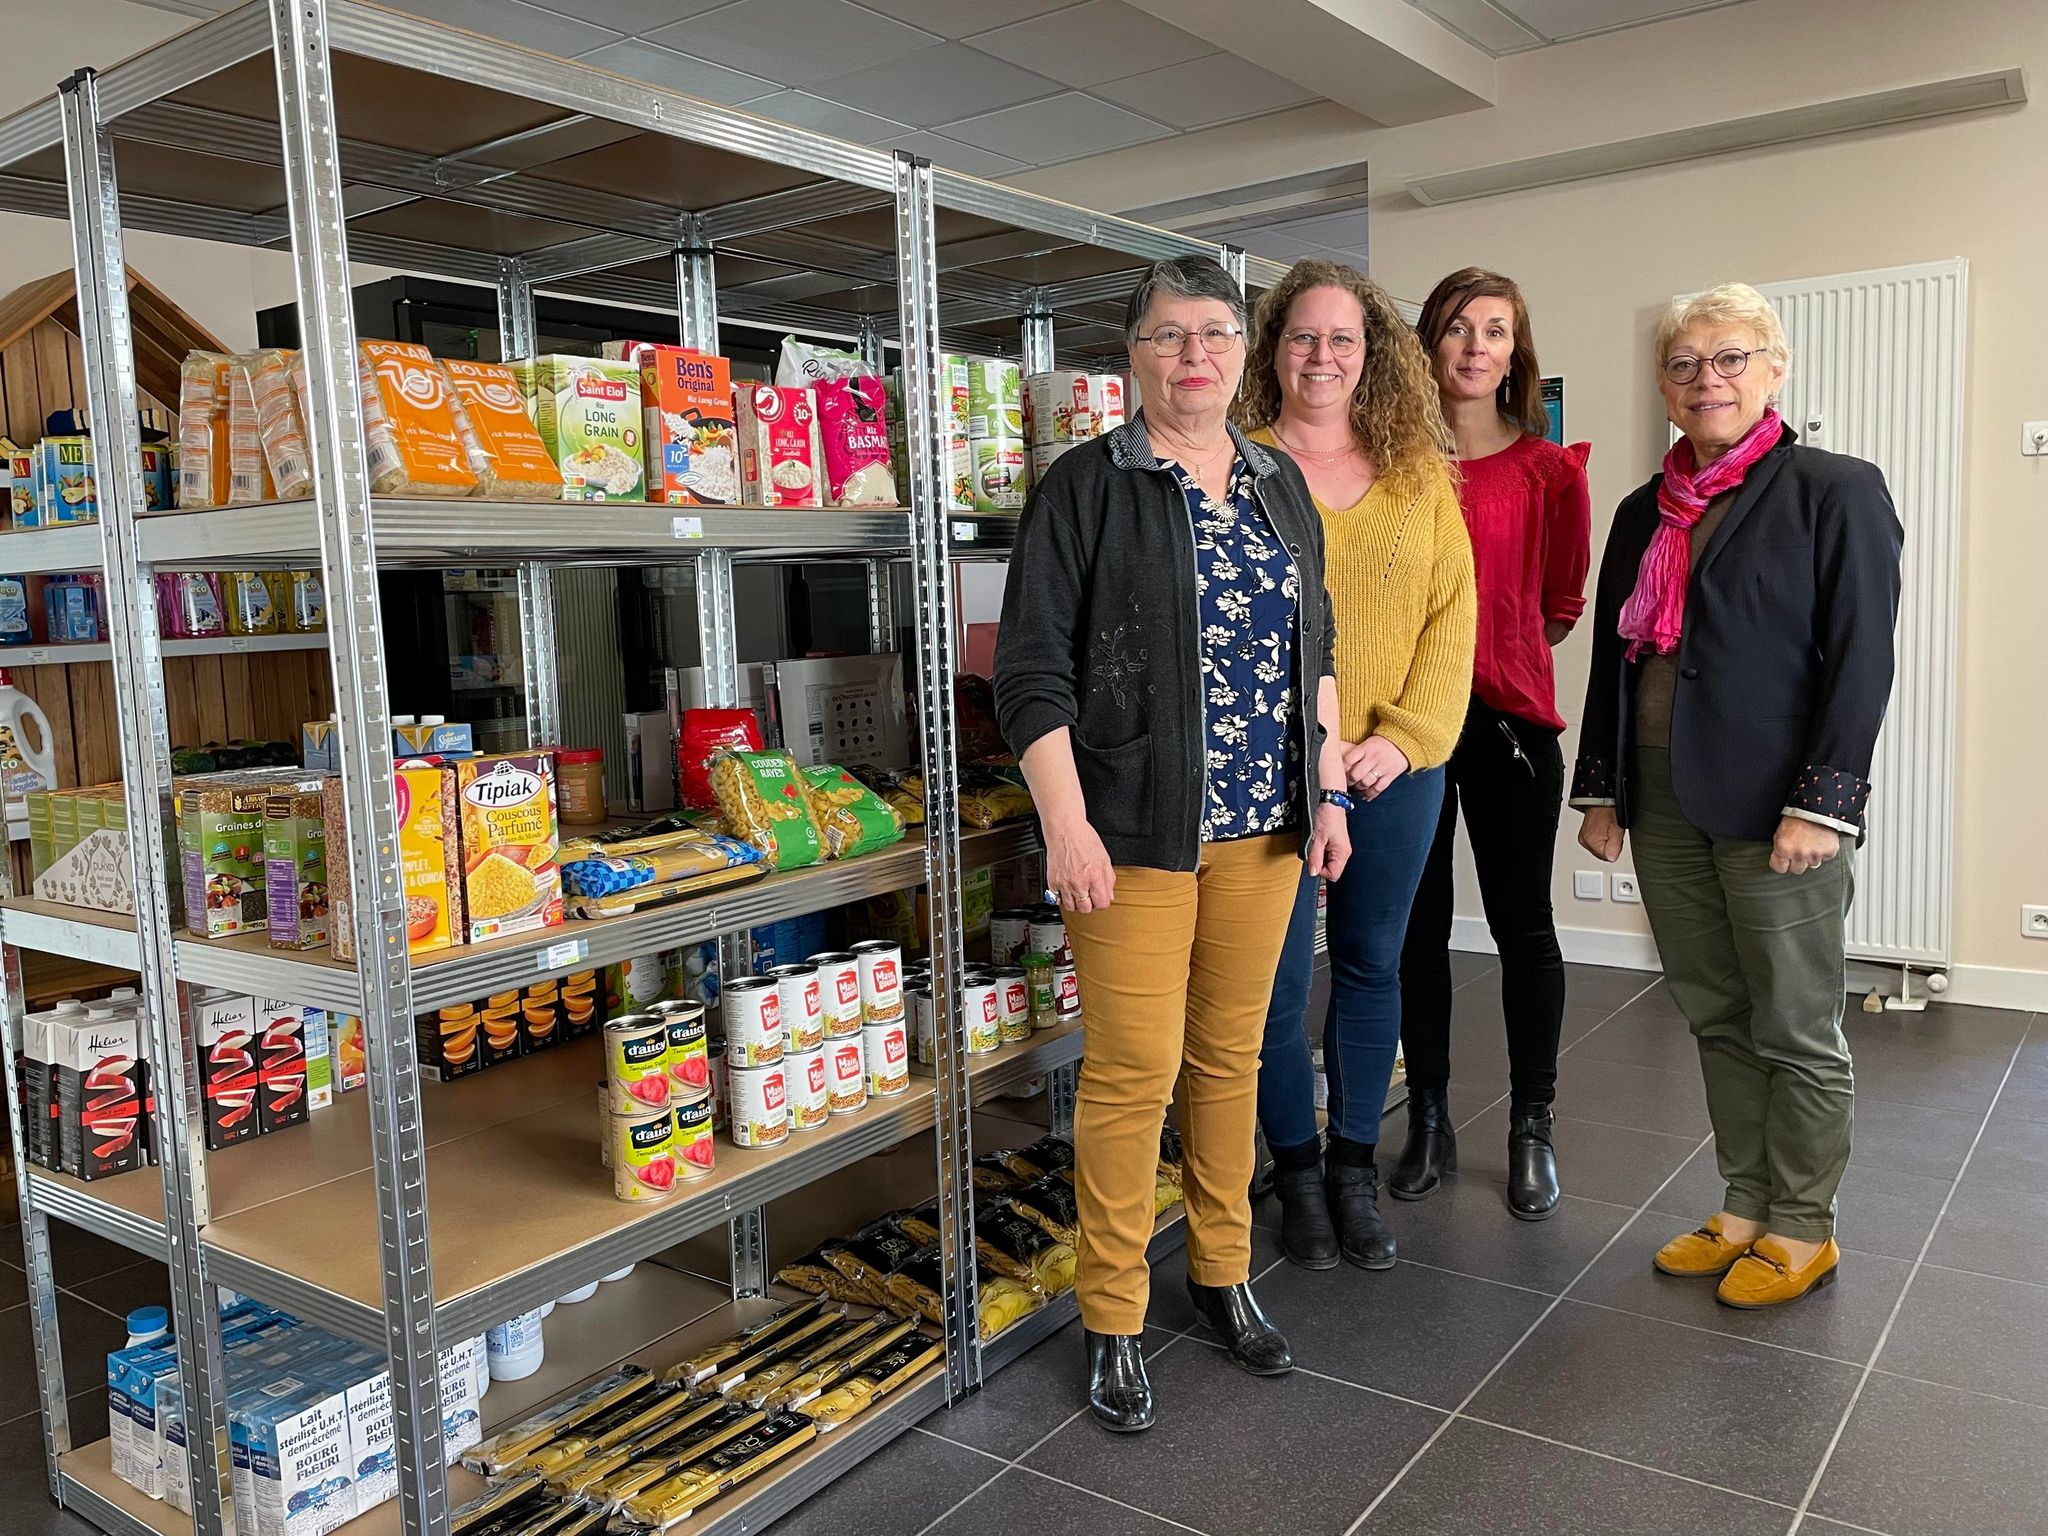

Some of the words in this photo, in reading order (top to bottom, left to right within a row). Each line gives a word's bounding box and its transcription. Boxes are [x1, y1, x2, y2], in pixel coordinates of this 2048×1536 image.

[675, 357, 714, 380] Ben's
[579, 383, 605, 397] Saint
[606, 386, 624, 398] Eloi
[677, 376, 715, 392] Original
[687, 395, 697, 403] Riz
[698, 396, 713, 407] Long
[714, 398, 729, 407] Grain
[585, 408, 616, 424] LONG
[797, 409, 808, 420] 10
[584, 423, 619, 438] GRAIN
[866, 426, 877, 434] Riz
[671, 451, 682, 463] 10
[190, 585, 207, 593] eco
[9, 771, 38, 785] Lessive
[9, 780, 39, 792] Liquide
[475, 777, 533, 805] Tipiak
[486, 806, 542, 823] Couscous
[215, 821, 254, 833] Graines
[488, 816, 542, 838] Parfumé
[672, 1023, 706, 1040] d'aucy
[628, 1039, 666, 1056] d'aucy
[628, 1063, 654, 1073] Tomates
[681, 1104, 712, 1122] d'aucy
[636, 1123, 672, 1141] d'aucy
[636, 1147, 660, 1158] Tomates
[438, 1347, 454, 1361] ait
[451, 1348, 475, 1366] U.H.T.
[441, 1361, 471, 1382] -écrémé
[369, 1375, 391, 1394] Lait
[349, 1391, 386, 1415] stérilisé
[441, 1388, 467, 1407] EURI
[299, 1408, 323, 1429] Lait
[357, 1401, 392, 1422] demi-écr
[279, 1425, 318, 1450] stérilisé
[319, 1409, 346, 1431] U.H.T.
[287, 1423, 342, 1458] demi-écrémé
[295, 1442, 338, 1471] BOURG
[296, 1454, 340, 1482] FLEURI
[321, 1521, 337, 1534] litre
